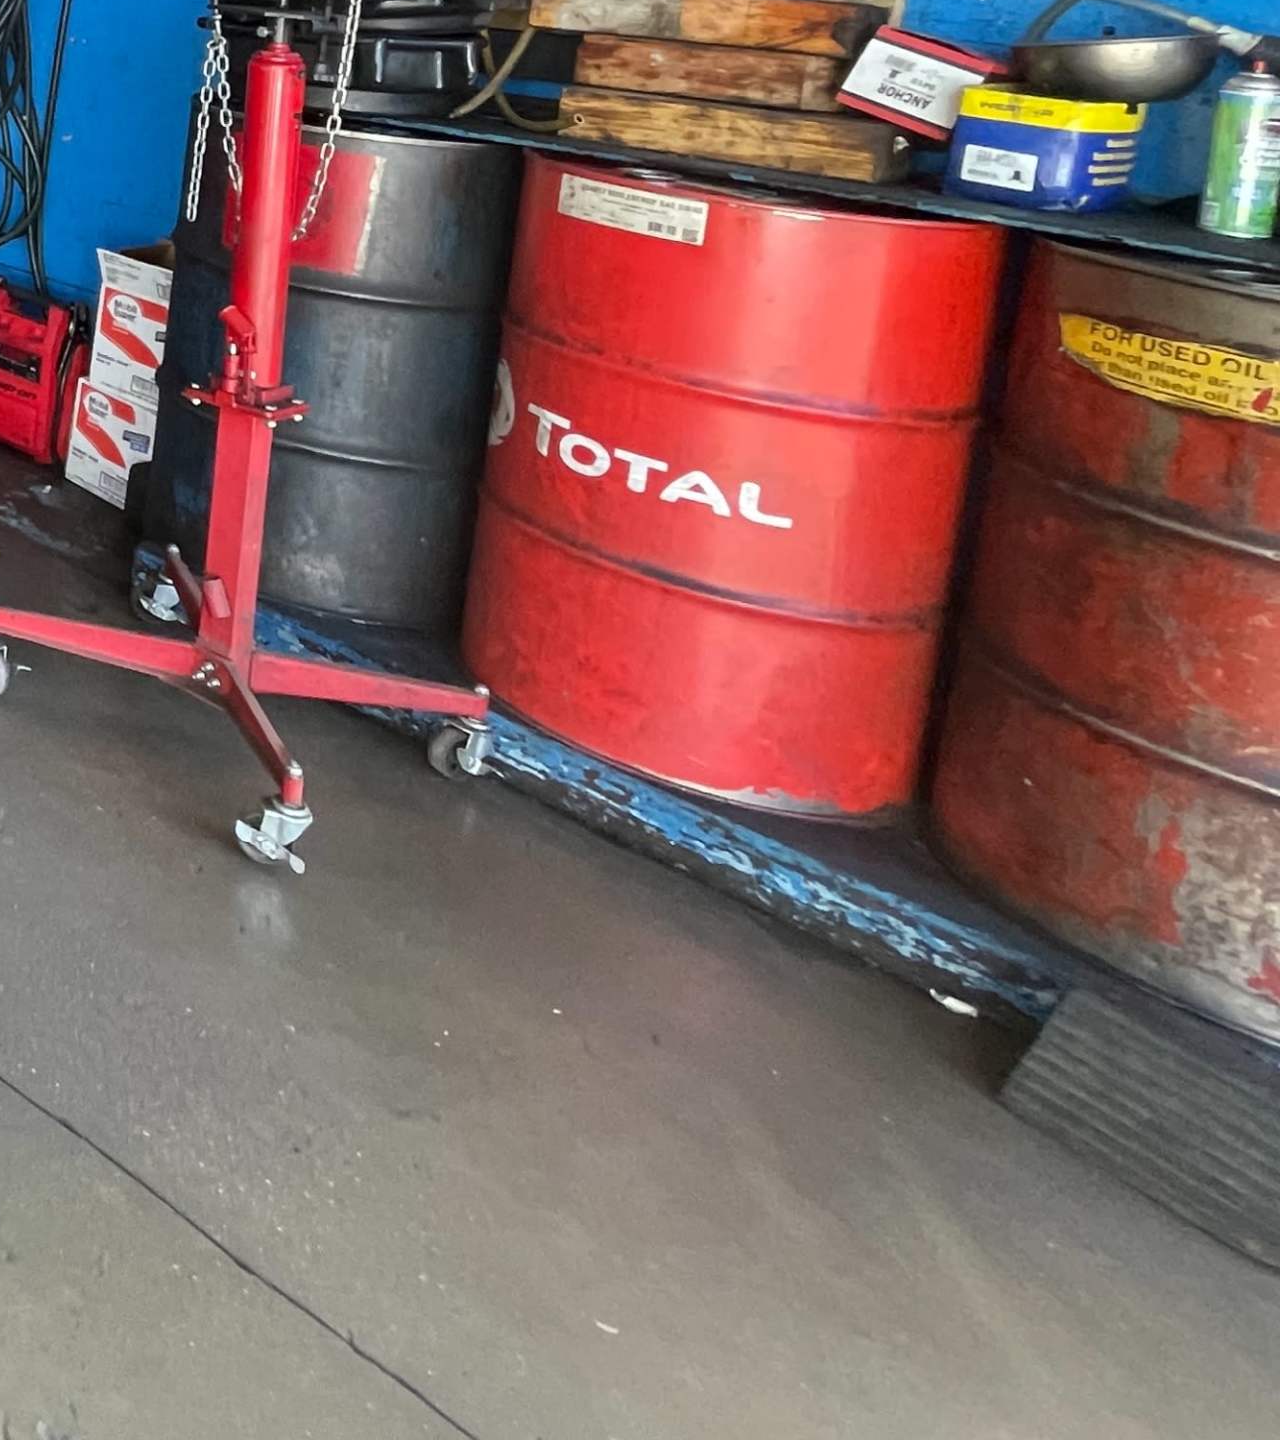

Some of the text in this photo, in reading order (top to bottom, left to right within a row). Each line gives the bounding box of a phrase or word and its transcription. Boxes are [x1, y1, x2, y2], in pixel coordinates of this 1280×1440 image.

[877, 82, 932, 110] ANCHOR
[1090, 322, 1268, 381] FOR USED OIL
[1092, 341, 1112, 357] Do
[1116, 351, 1143, 367] not
[1148, 361, 1201, 381] place
[1107, 362, 1141, 381] than
[1203, 390, 1229, 404] oil
[528, 402, 793, 529] TOTAL
